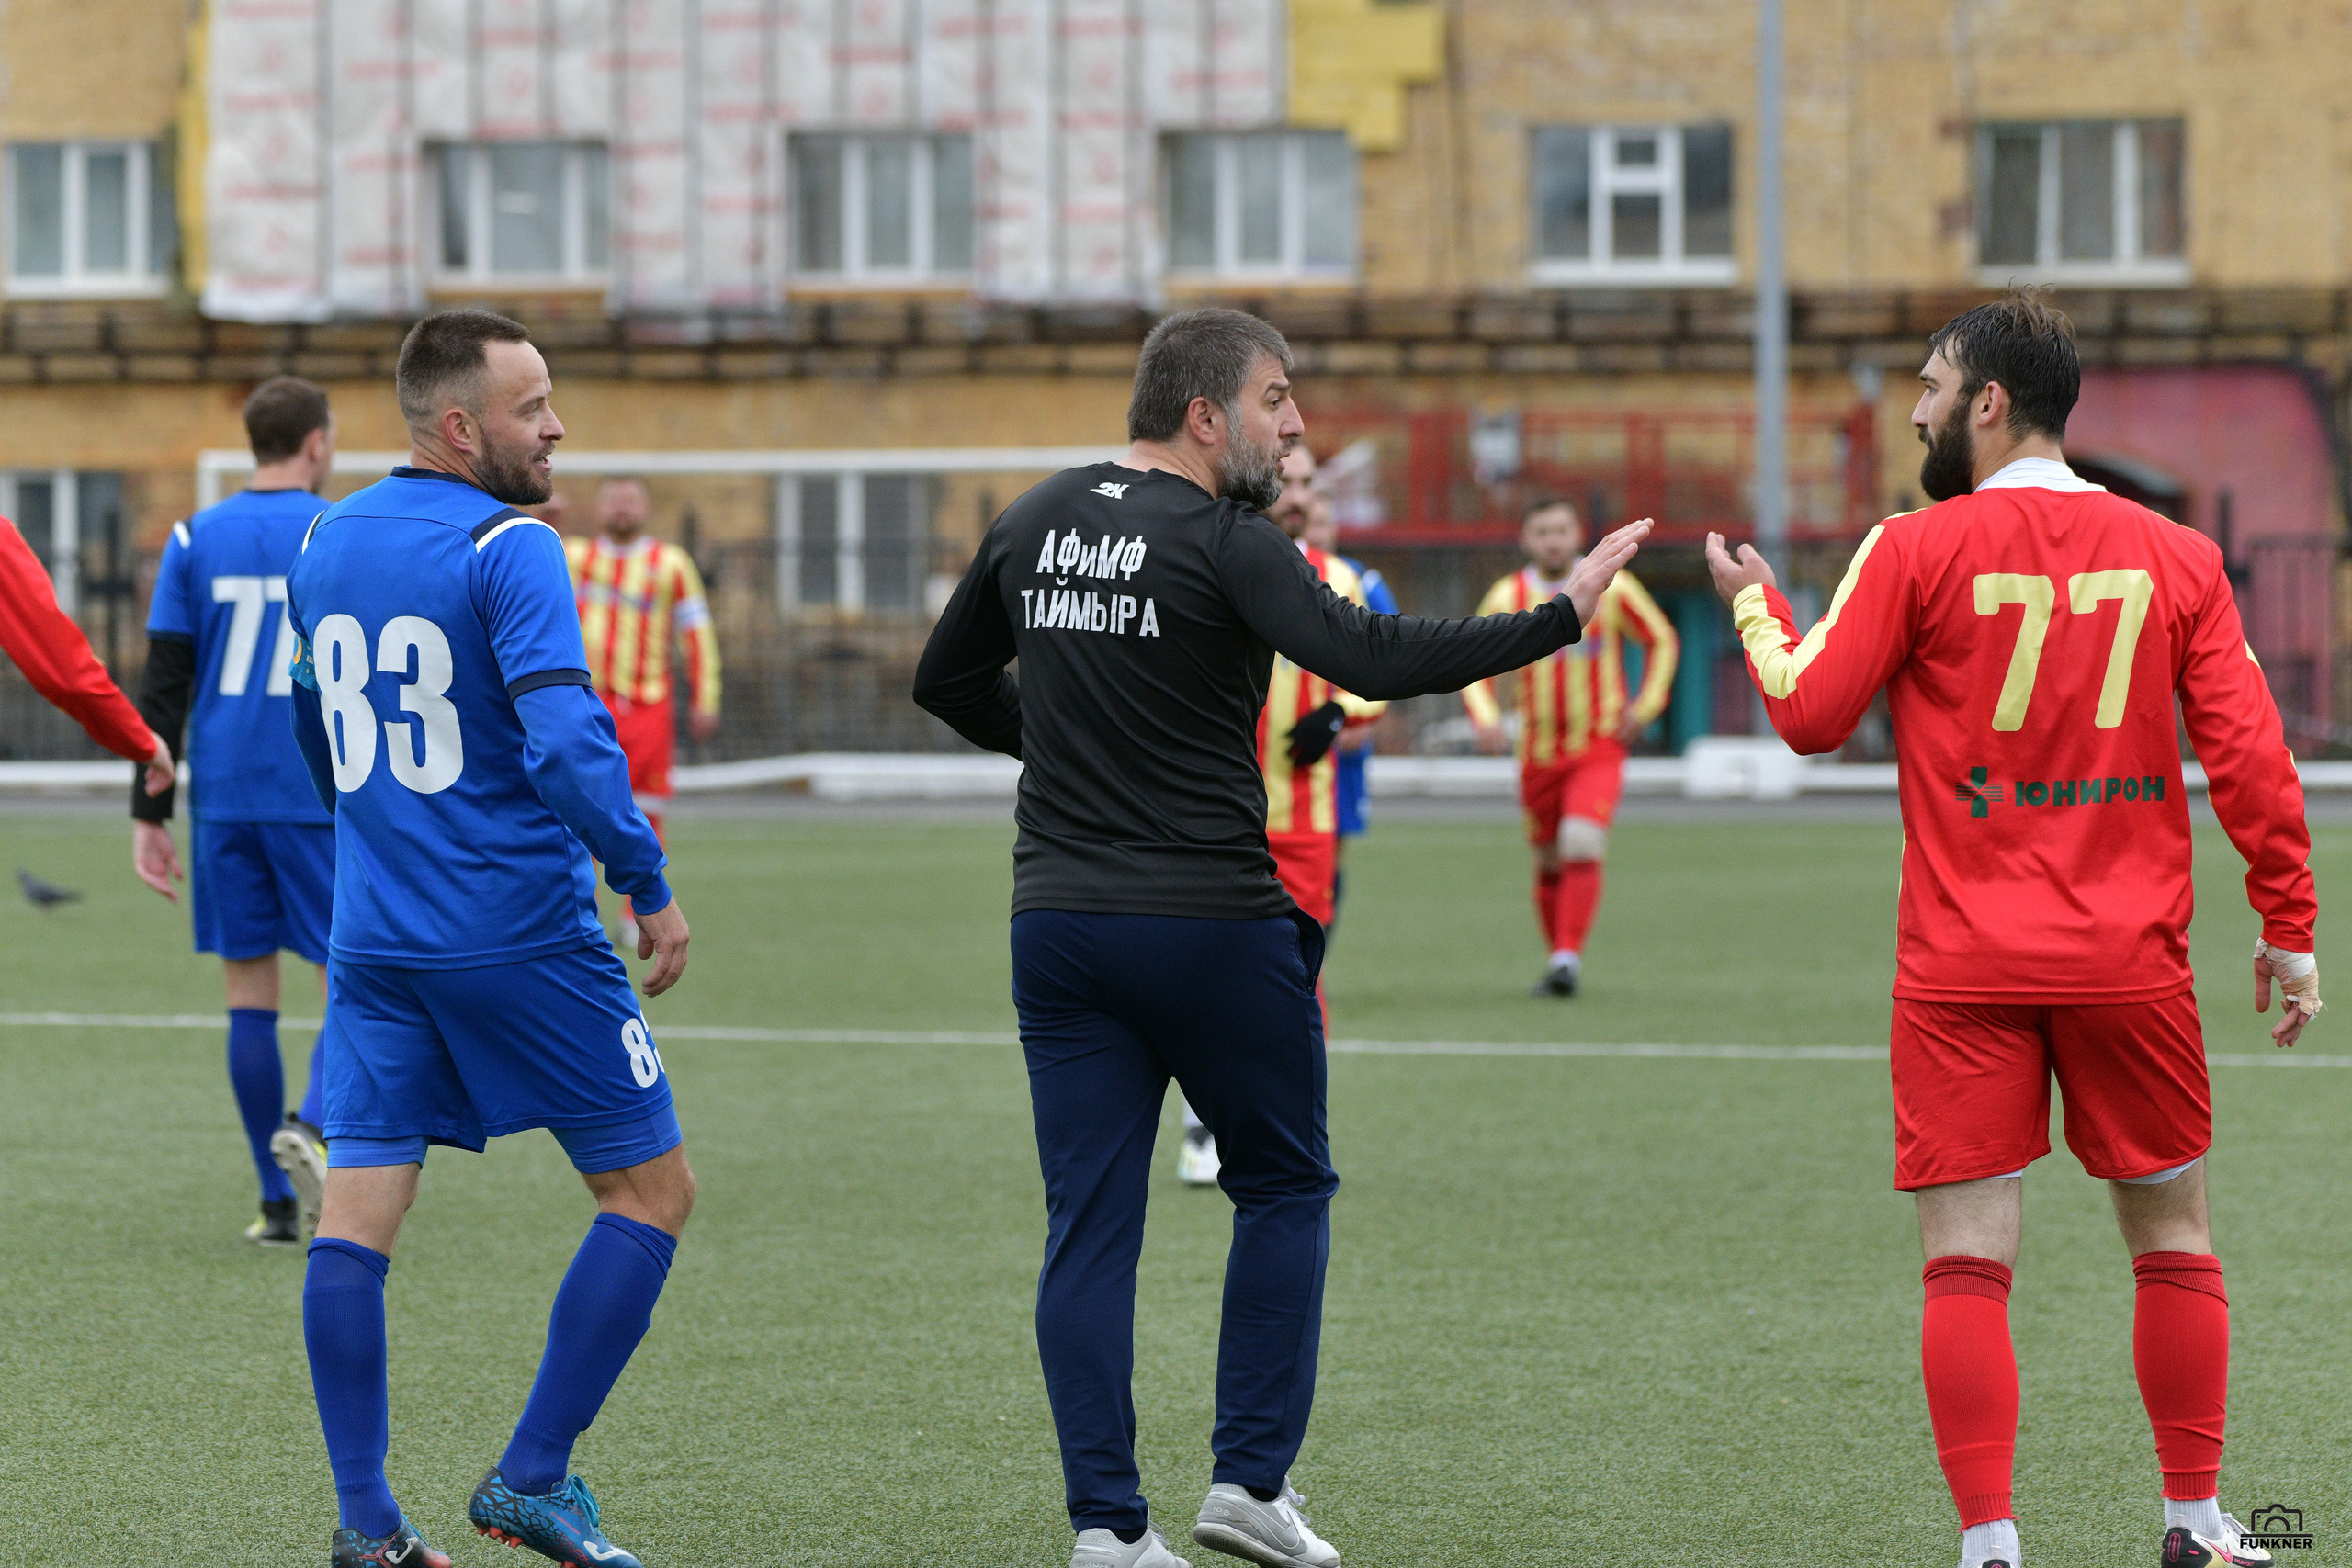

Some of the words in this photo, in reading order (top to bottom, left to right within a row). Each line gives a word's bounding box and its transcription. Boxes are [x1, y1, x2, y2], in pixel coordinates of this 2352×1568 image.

[1021, 577, 1160, 637] ТАЙМЫРА
[1973, 569, 2154, 731] 77
[313, 613, 464, 795] 83
[2015, 776, 2165, 807] ЮНИРОН
